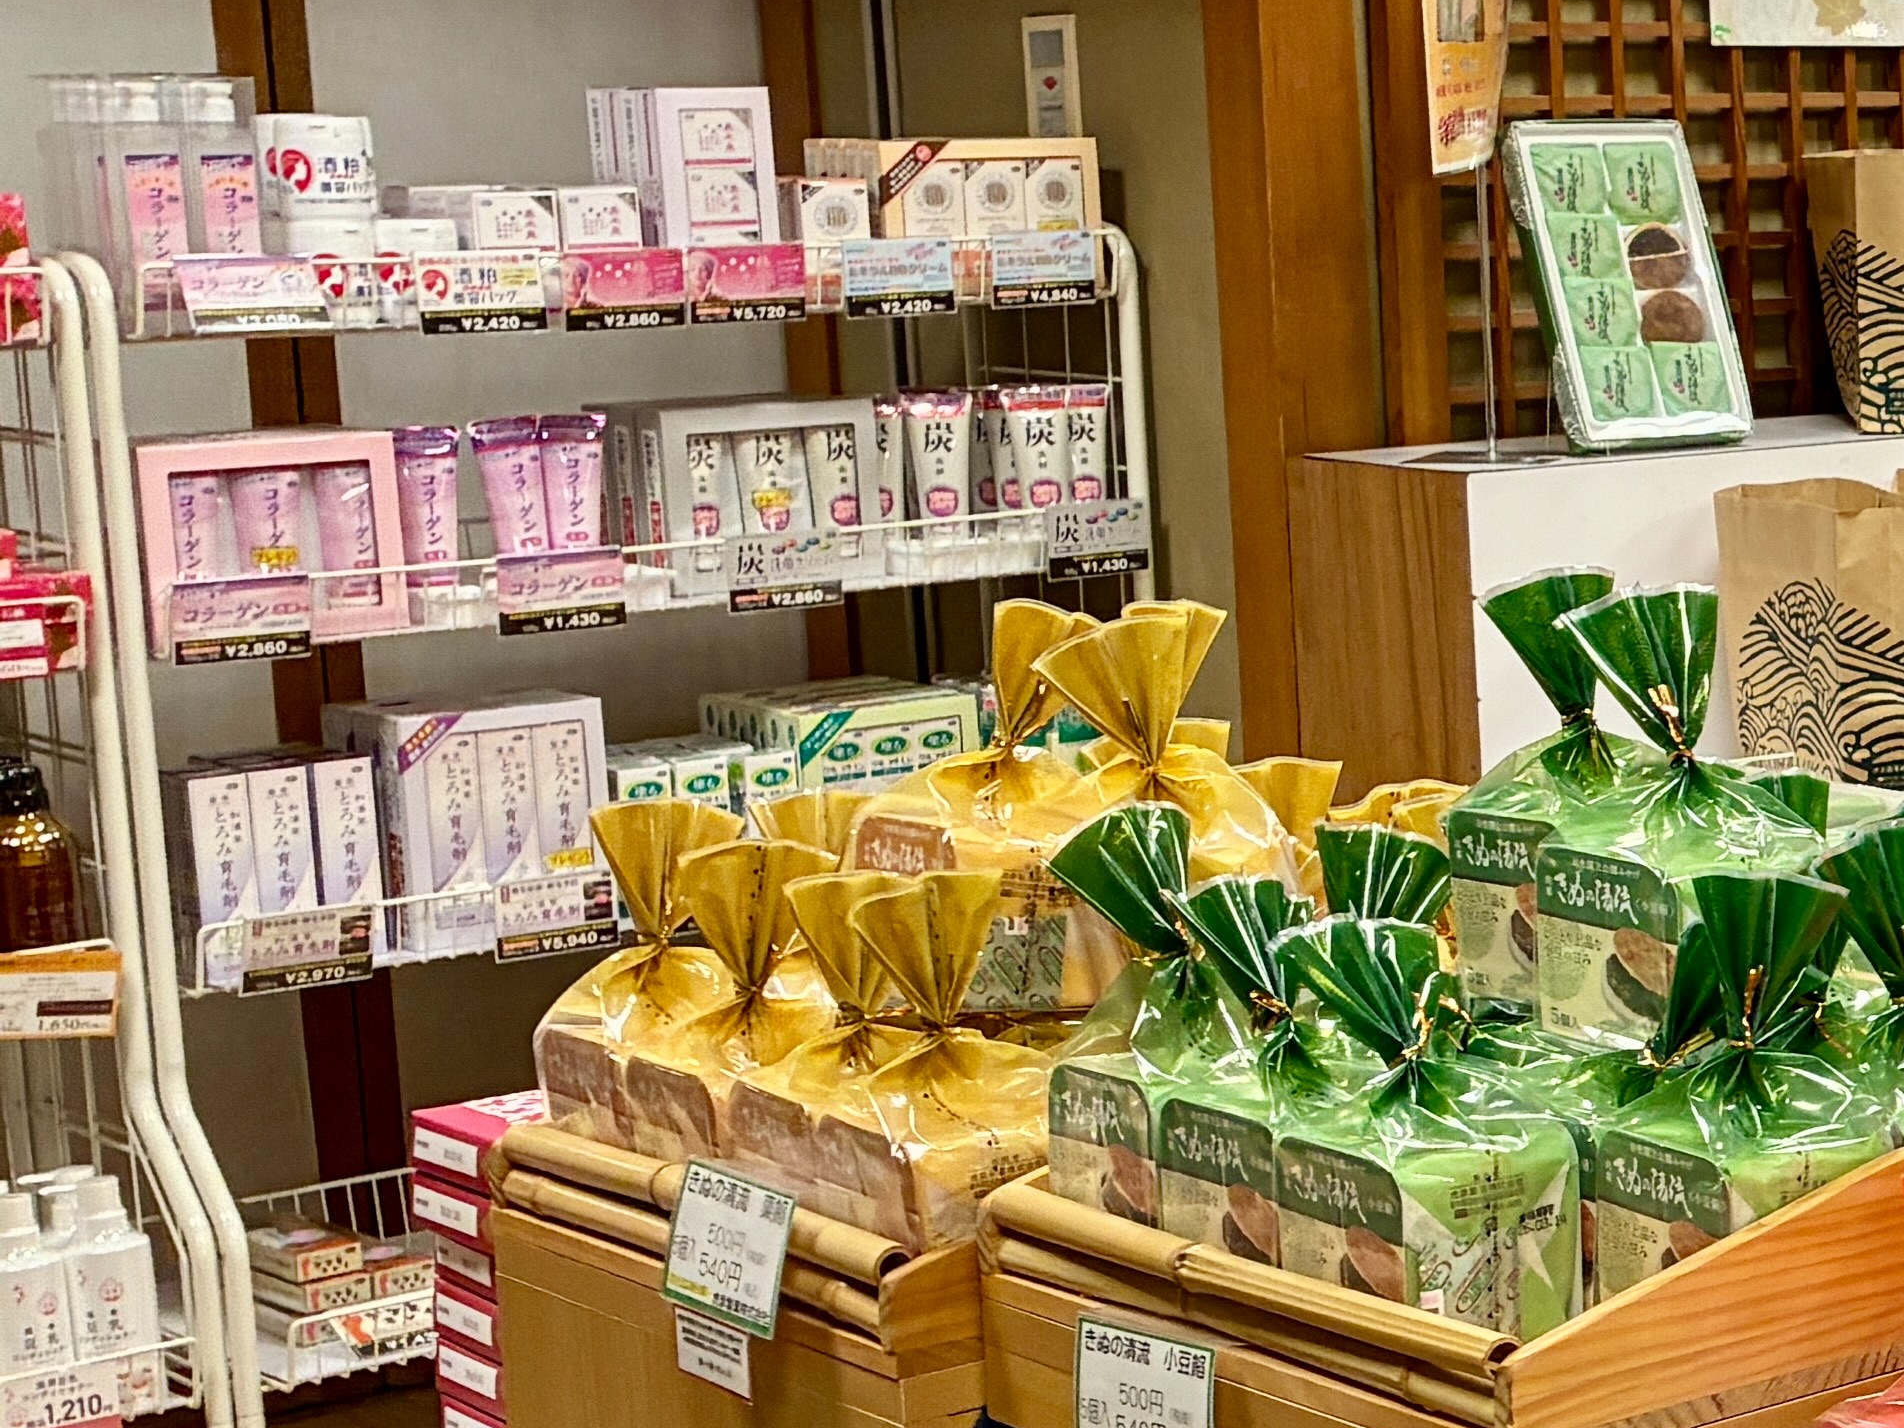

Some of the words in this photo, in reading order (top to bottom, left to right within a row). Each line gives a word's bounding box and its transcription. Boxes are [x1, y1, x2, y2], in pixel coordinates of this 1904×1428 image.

[734, 302, 788, 320] ¥5,720
[881, 294, 933, 312] ¥2,420
[461, 314, 521, 327] ¥2,420
[923, 422, 956, 454] 炭
[1027, 416, 1056, 448] 炭
[1055, 512, 1080, 544] 炭
[736, 542, 765, 575] 炭
[1081, 557, 1129, 574] ¥1,430
[183, 602, 269, 624] コラーゲン
[225, 641, 288, 658] ¥2,860
[1084, 1328, 1151, 1366] きぬの清流
[1118, 1382, 1165, 1417] 500円
